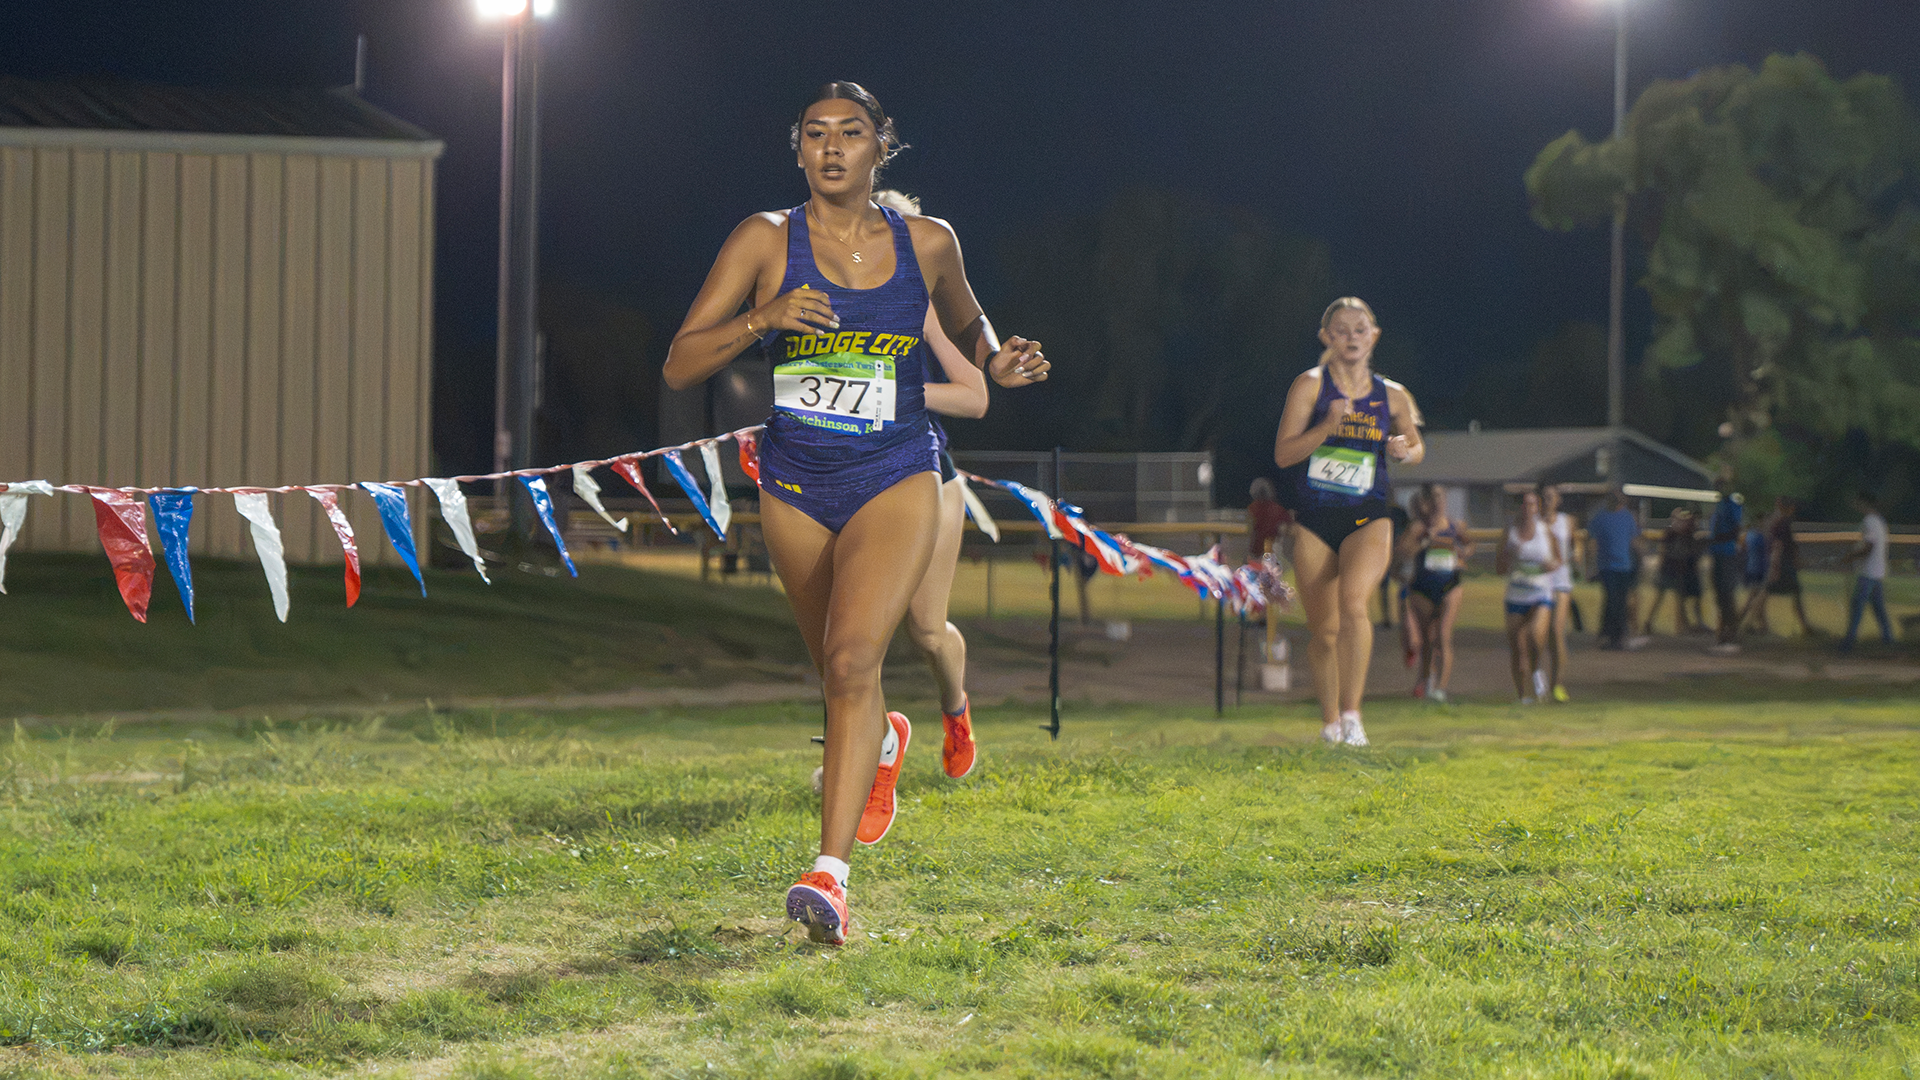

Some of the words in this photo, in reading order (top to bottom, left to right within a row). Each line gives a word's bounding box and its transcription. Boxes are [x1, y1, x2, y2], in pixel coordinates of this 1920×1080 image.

[785, 331, 872, 358] DODGE
[868, 333, 919, 356] CITY
[855, 361, 892, 371] Twilht
[800, 376, 870, 415] 377
[784, 411, 862, 434] tchinson,
[865, 423, 874, 434] K
[1340, 411, 1376, 427] ANSAS
[1337, 424, 1383, 441] ESLEYAN
[1320, 461, 1360, 483] 427
